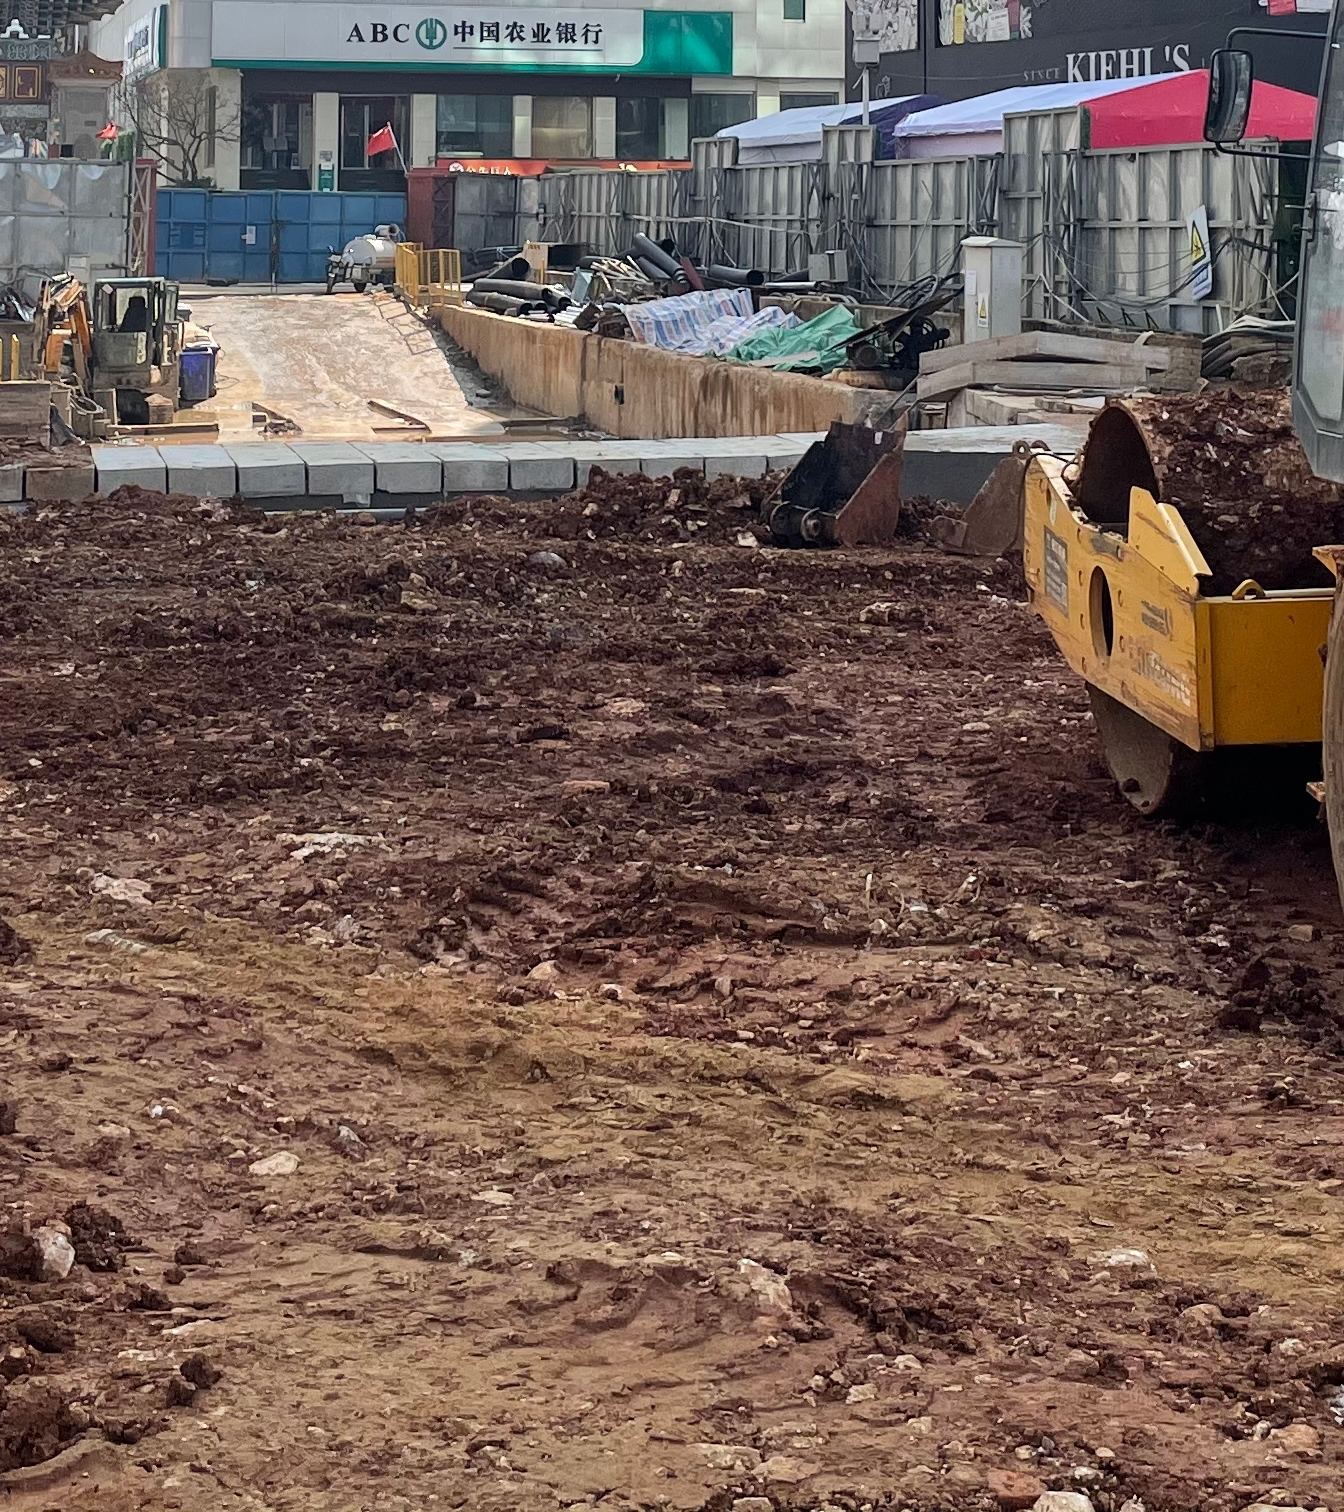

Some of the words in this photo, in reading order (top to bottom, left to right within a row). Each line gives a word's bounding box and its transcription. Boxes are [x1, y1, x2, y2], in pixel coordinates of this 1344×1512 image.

[347, 22, 410, 44] ABC
[453, 20, 603, 45] 中国农业银行
[1023, 67, 1060, 82] SINCE
